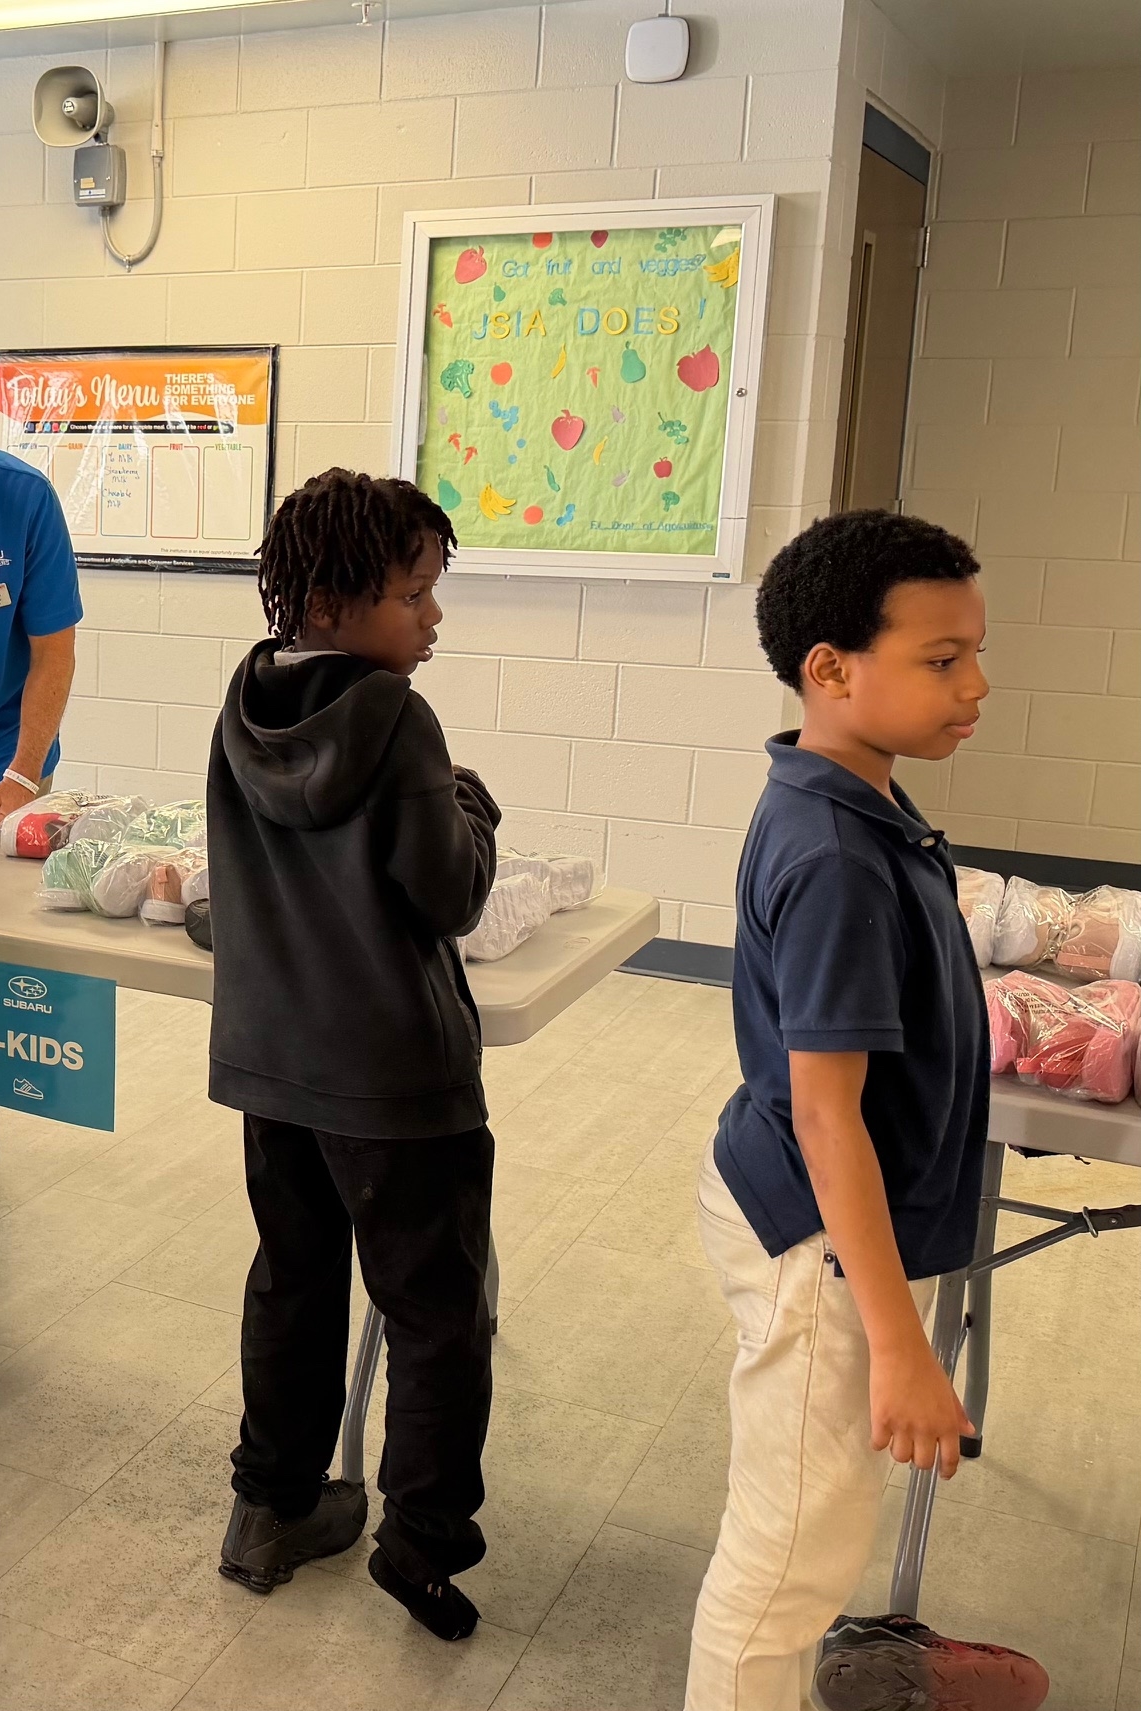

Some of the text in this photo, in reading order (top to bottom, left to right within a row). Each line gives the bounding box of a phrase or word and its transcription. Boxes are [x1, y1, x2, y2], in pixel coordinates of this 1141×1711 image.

[502, 259, 531, 278] Got
[546, 257, 572, 276] fruit
[591, 256, 623, 275] and
[473, 309, 547, 340] JSIA
[577, 306, 680, 336] DOES
[164, 373, 215, 383] THERE'S
[7, 374, 88, 415] Today's
[91, 373, 160, 411] Menu
[163, 383, 236, 395] SOMETHING
[163, 394, 256, 406] FOR EVERYONE
[3, 998, 52, 1014] SUBARU
